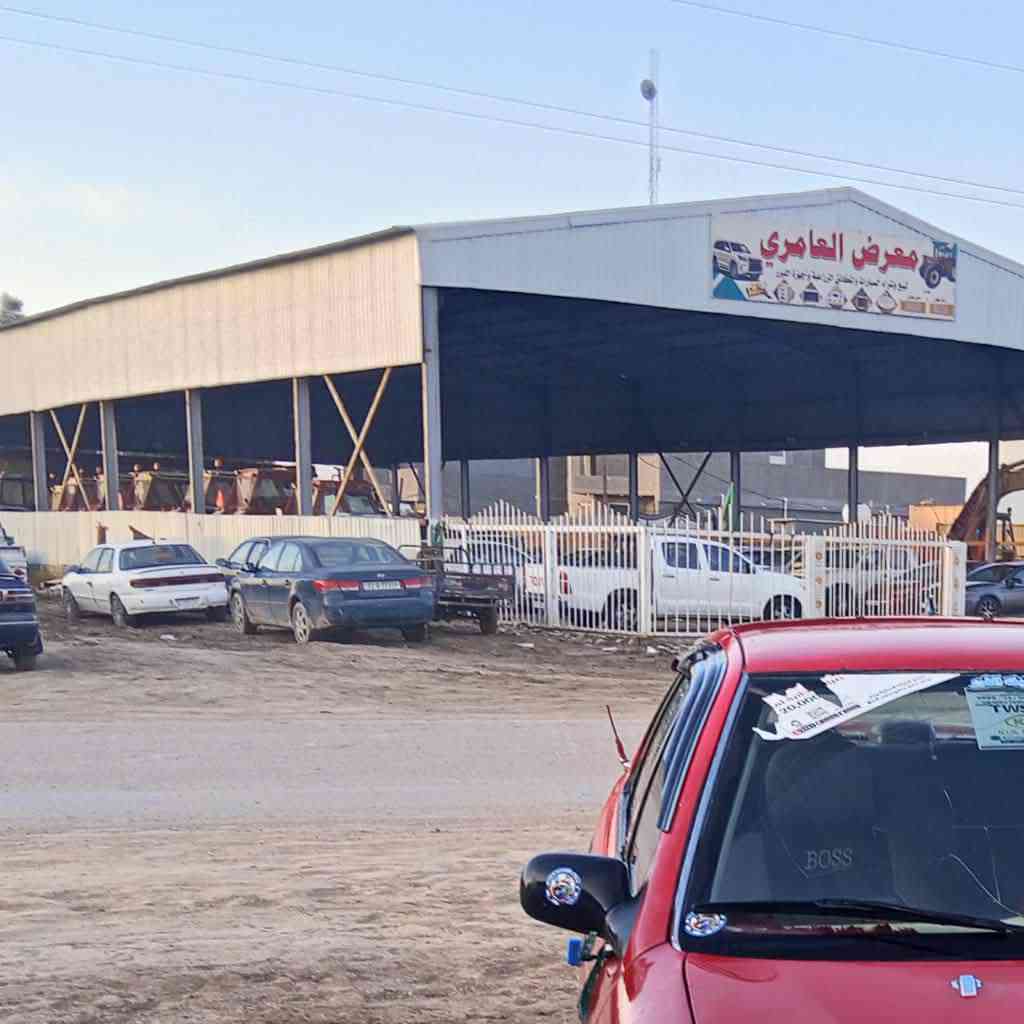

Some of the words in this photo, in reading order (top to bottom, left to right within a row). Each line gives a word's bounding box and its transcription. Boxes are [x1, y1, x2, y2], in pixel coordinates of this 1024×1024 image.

[760, 229, 844, 268] العامري
[851, 235, 919, 274] معرض
[805, 847, 854, 871] BOSS
